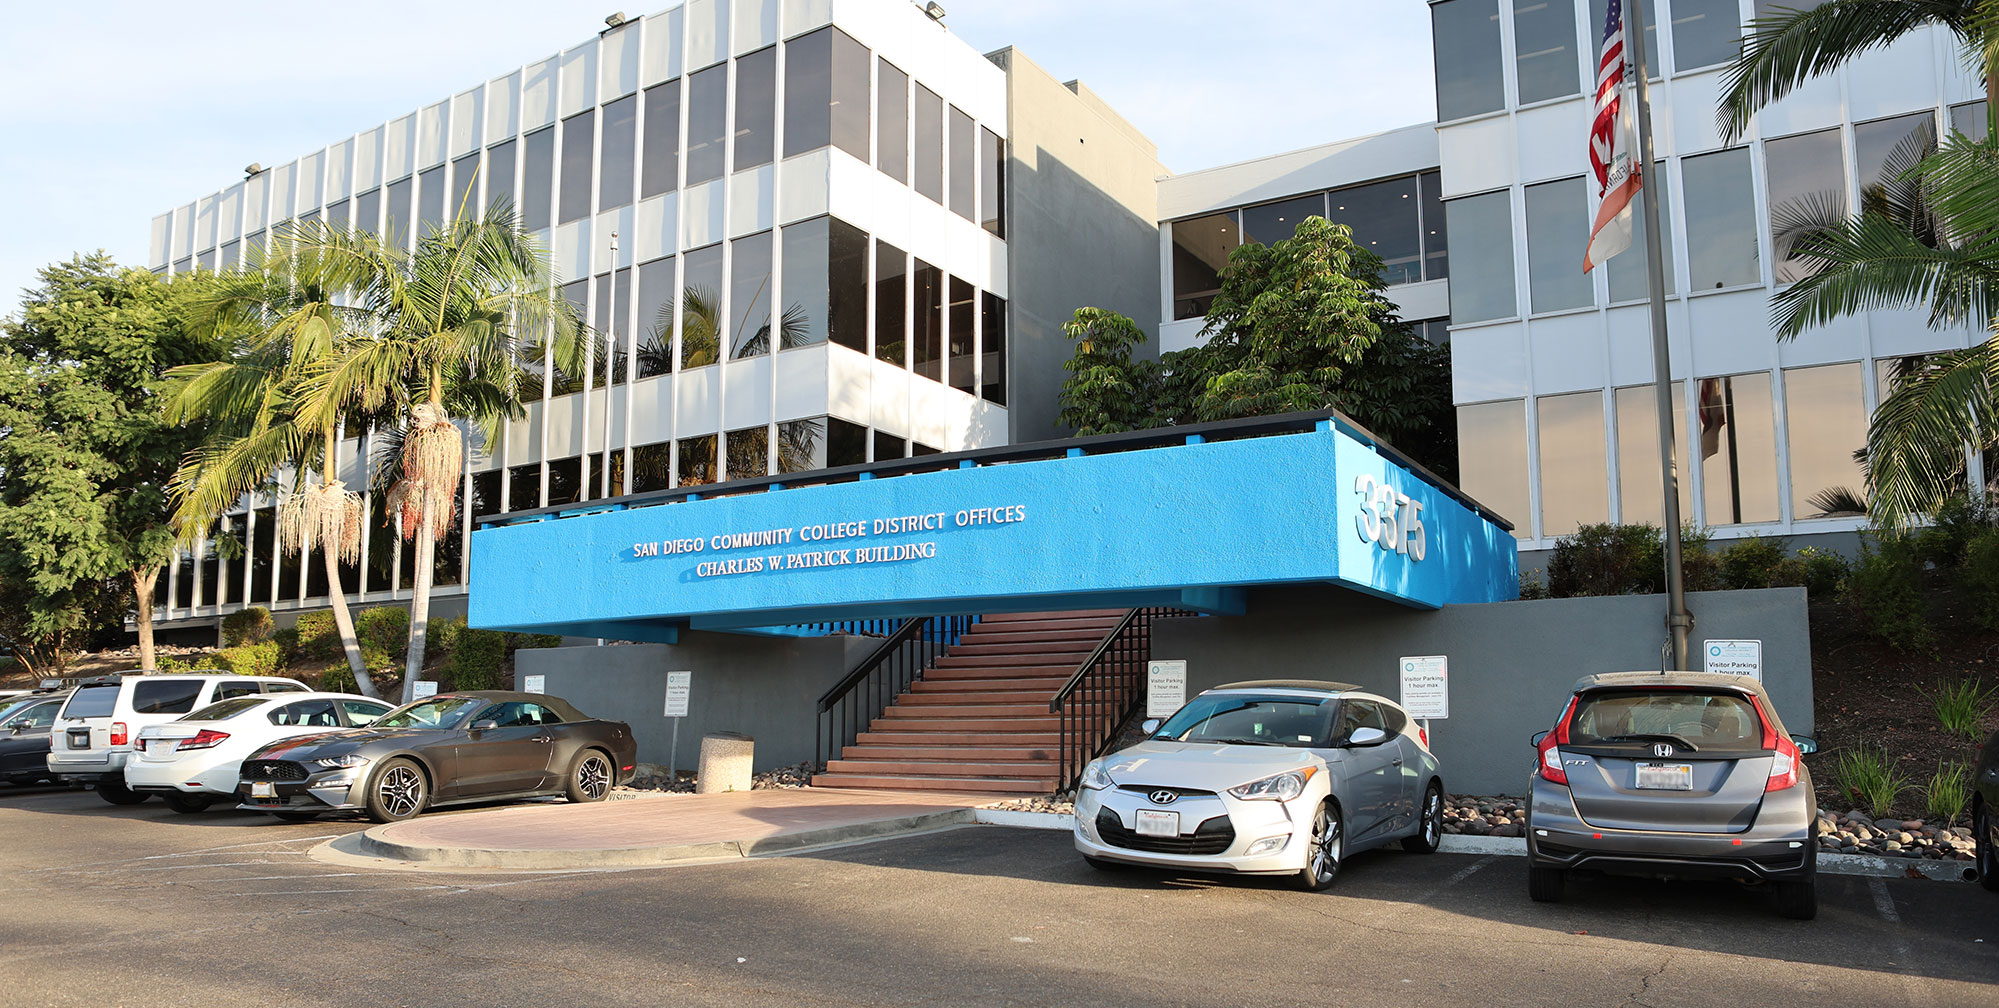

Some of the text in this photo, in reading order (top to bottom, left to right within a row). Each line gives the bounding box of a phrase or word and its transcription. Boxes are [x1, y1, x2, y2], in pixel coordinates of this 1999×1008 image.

[633, 504, 1026, 558] SAN DIEGO COMMUNITY COLLEGE DISTRICT OFFICES
[1355, 474, 1426, 562] 3375
[696, 541, 937, 578] CHARLES W. PATRICK BUILDING
[1731, 661, 1758, 669] Parking
